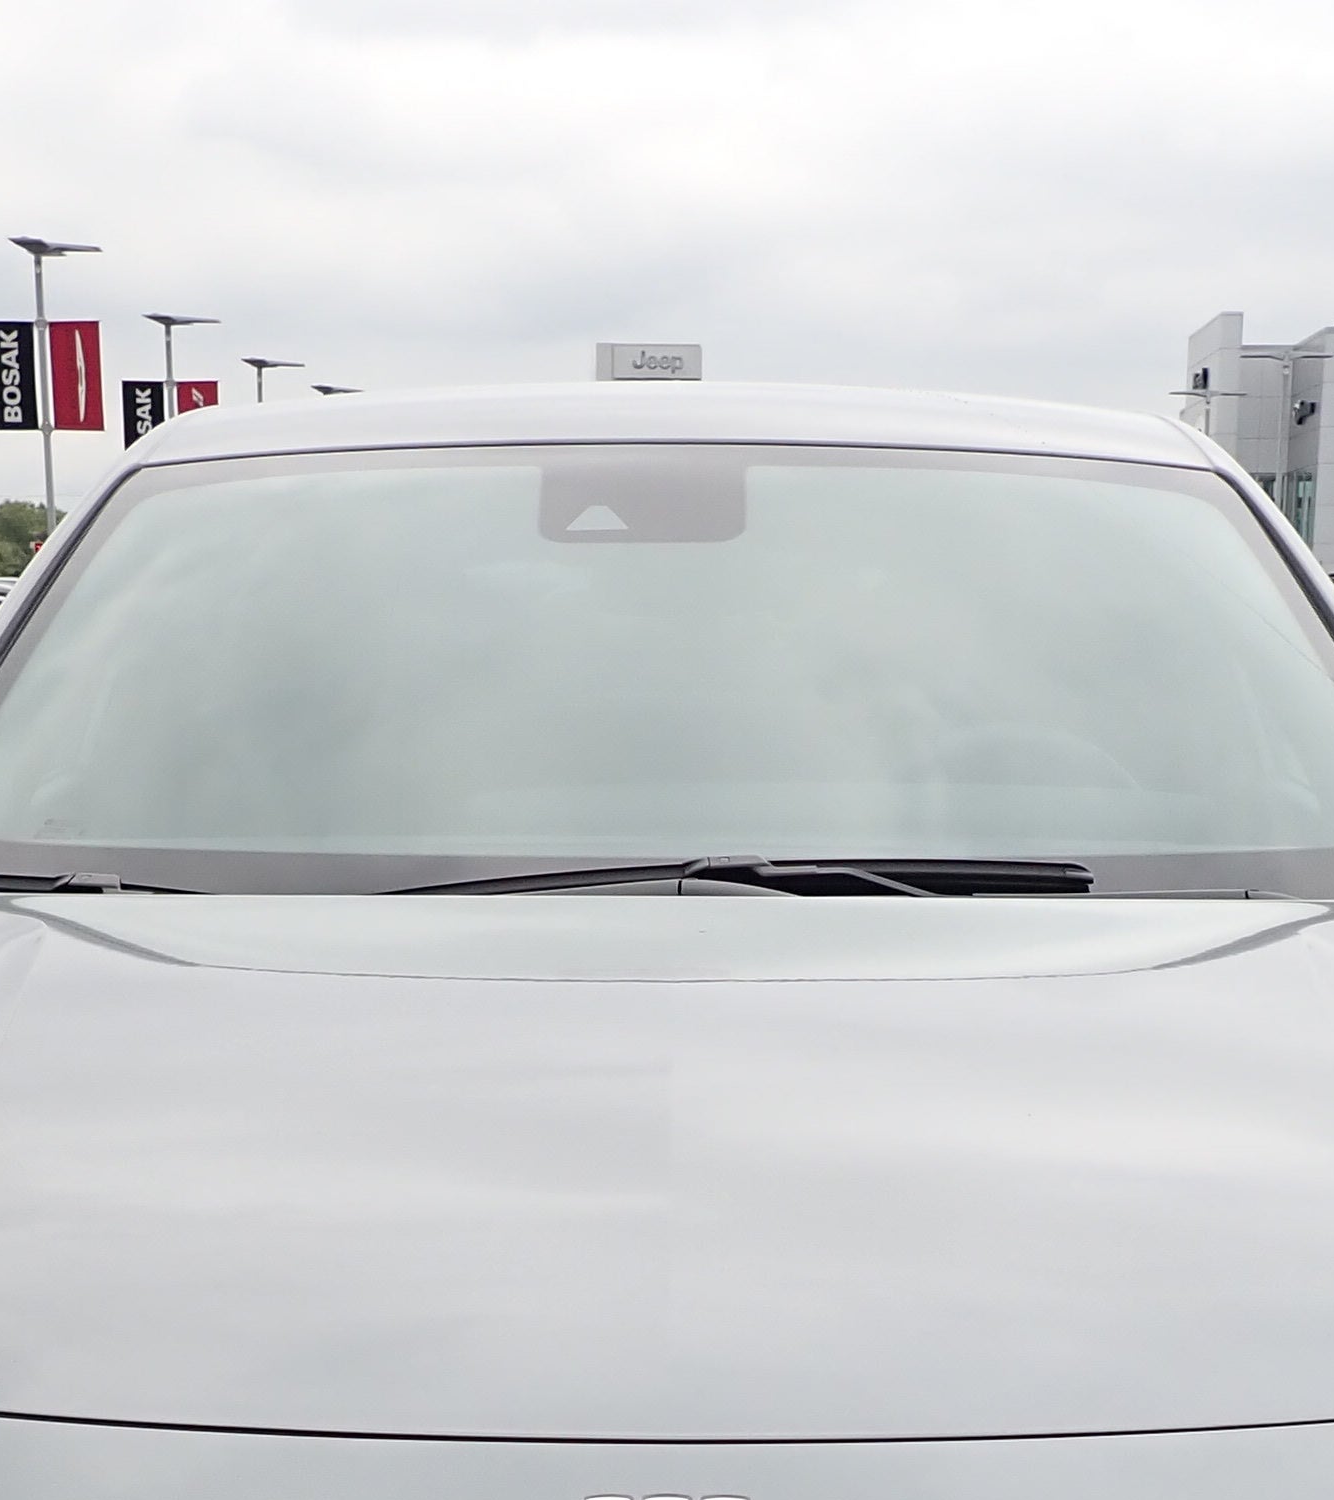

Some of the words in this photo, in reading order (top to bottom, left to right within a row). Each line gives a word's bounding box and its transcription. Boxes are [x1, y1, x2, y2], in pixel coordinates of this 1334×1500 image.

[0, 329, 23, 423] BOSAK
[632, 350, 684, 374] Jeep
[135, 388, 153, 434] SAK
